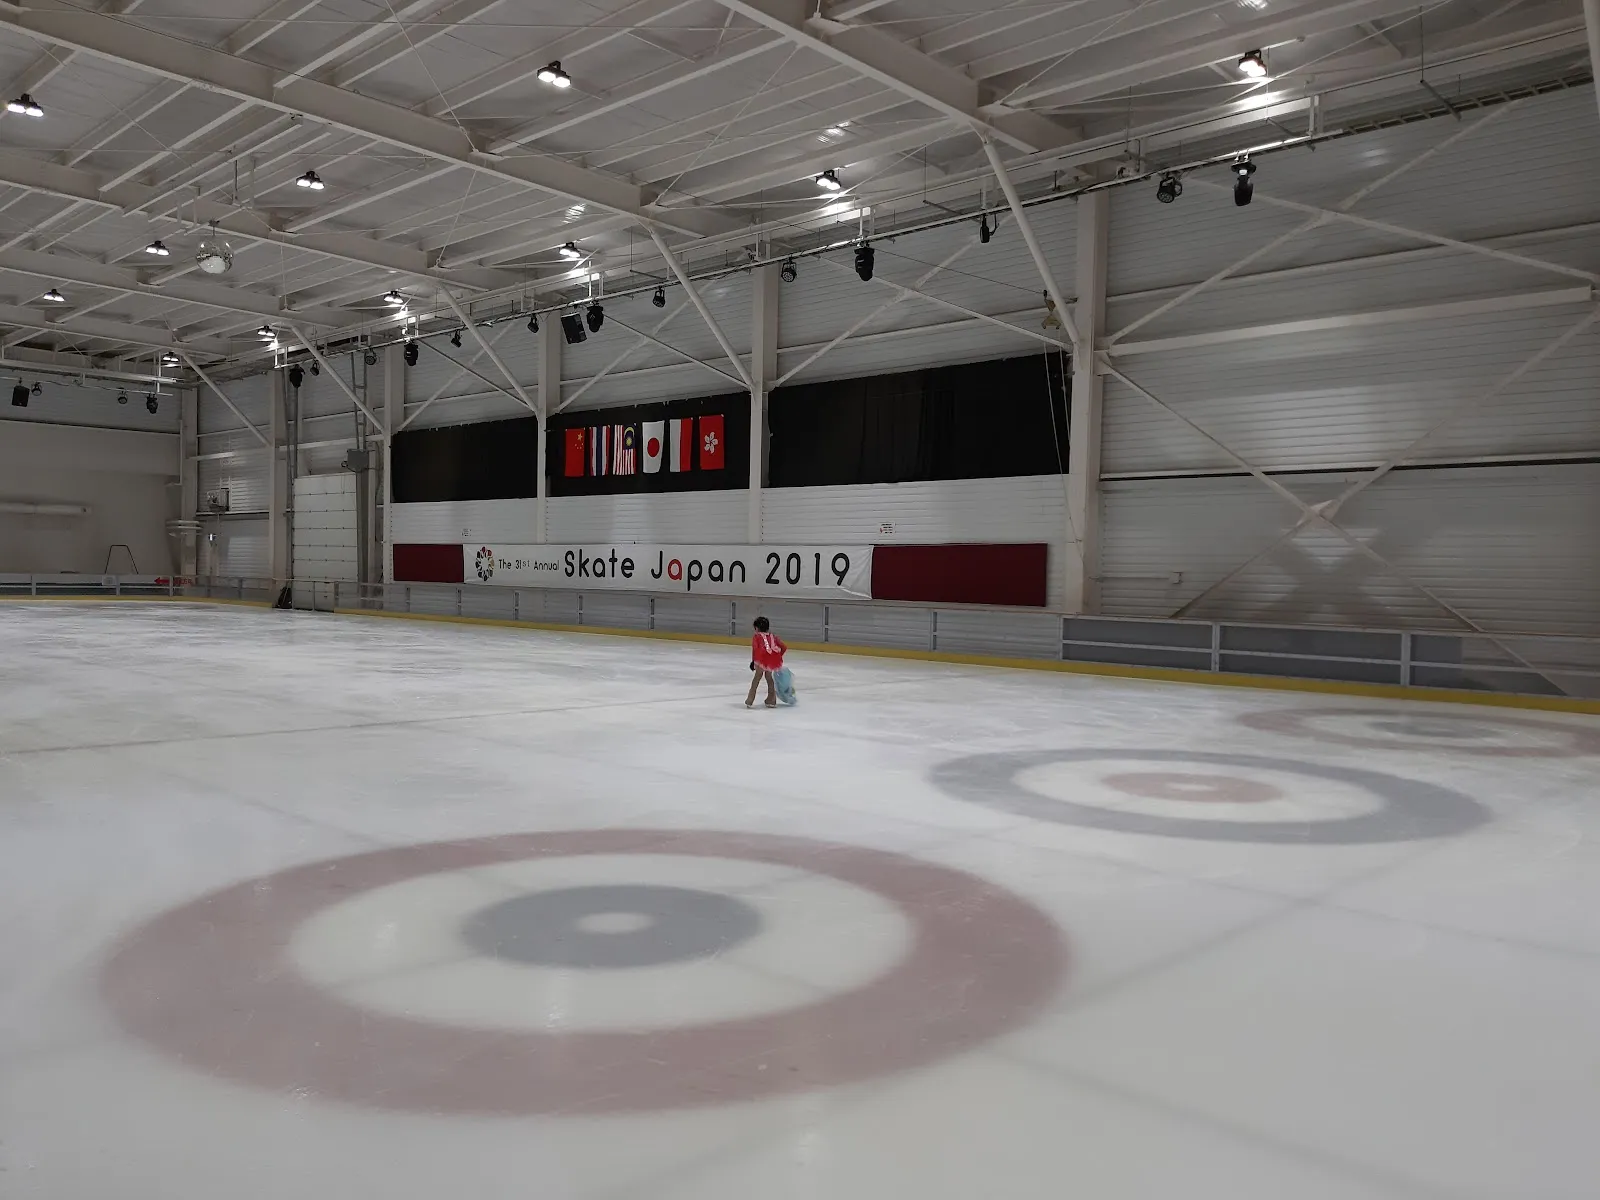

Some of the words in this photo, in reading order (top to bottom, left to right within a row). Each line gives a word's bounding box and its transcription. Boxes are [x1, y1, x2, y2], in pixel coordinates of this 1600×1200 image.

[498, 558, 512, 570] The
[515, 559, 530, 570] 31st
[533, 559, 560, 571] Annual
[564, 548, 635, 579] Skate
[650, 550, 746, 592] Japan
[765, 552, 850, 586] 2019
